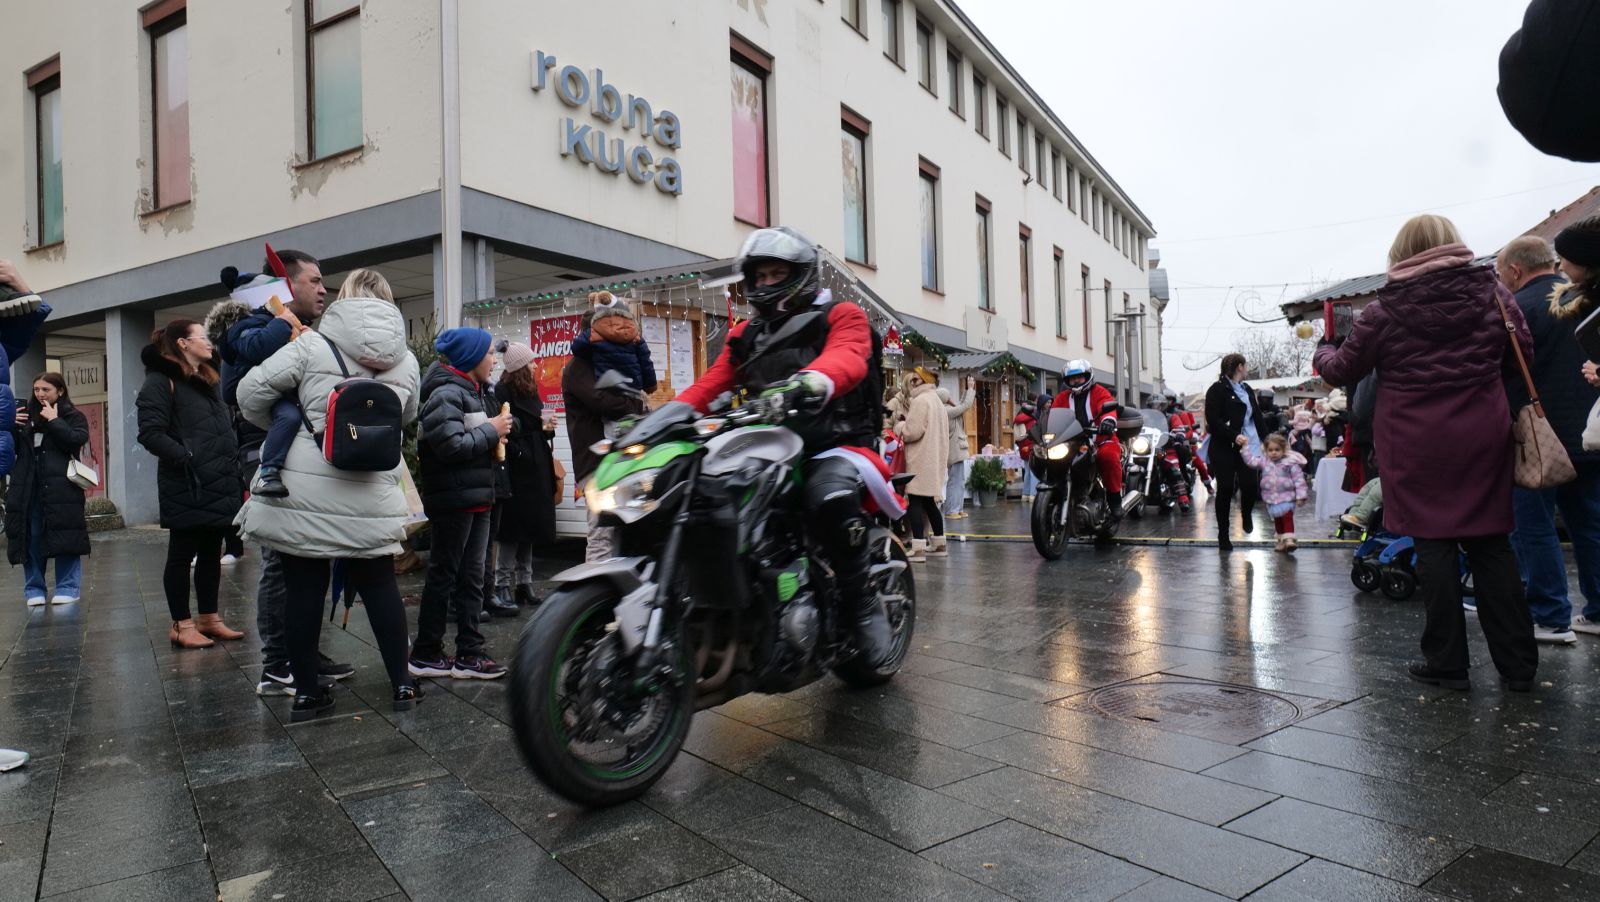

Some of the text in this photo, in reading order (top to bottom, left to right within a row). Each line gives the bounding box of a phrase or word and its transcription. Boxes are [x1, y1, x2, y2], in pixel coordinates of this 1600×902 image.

[530, 50, 681, 150] robna
[532, 340, 573, 358] LANGO
[73, 366, 98, 384] YUKI
